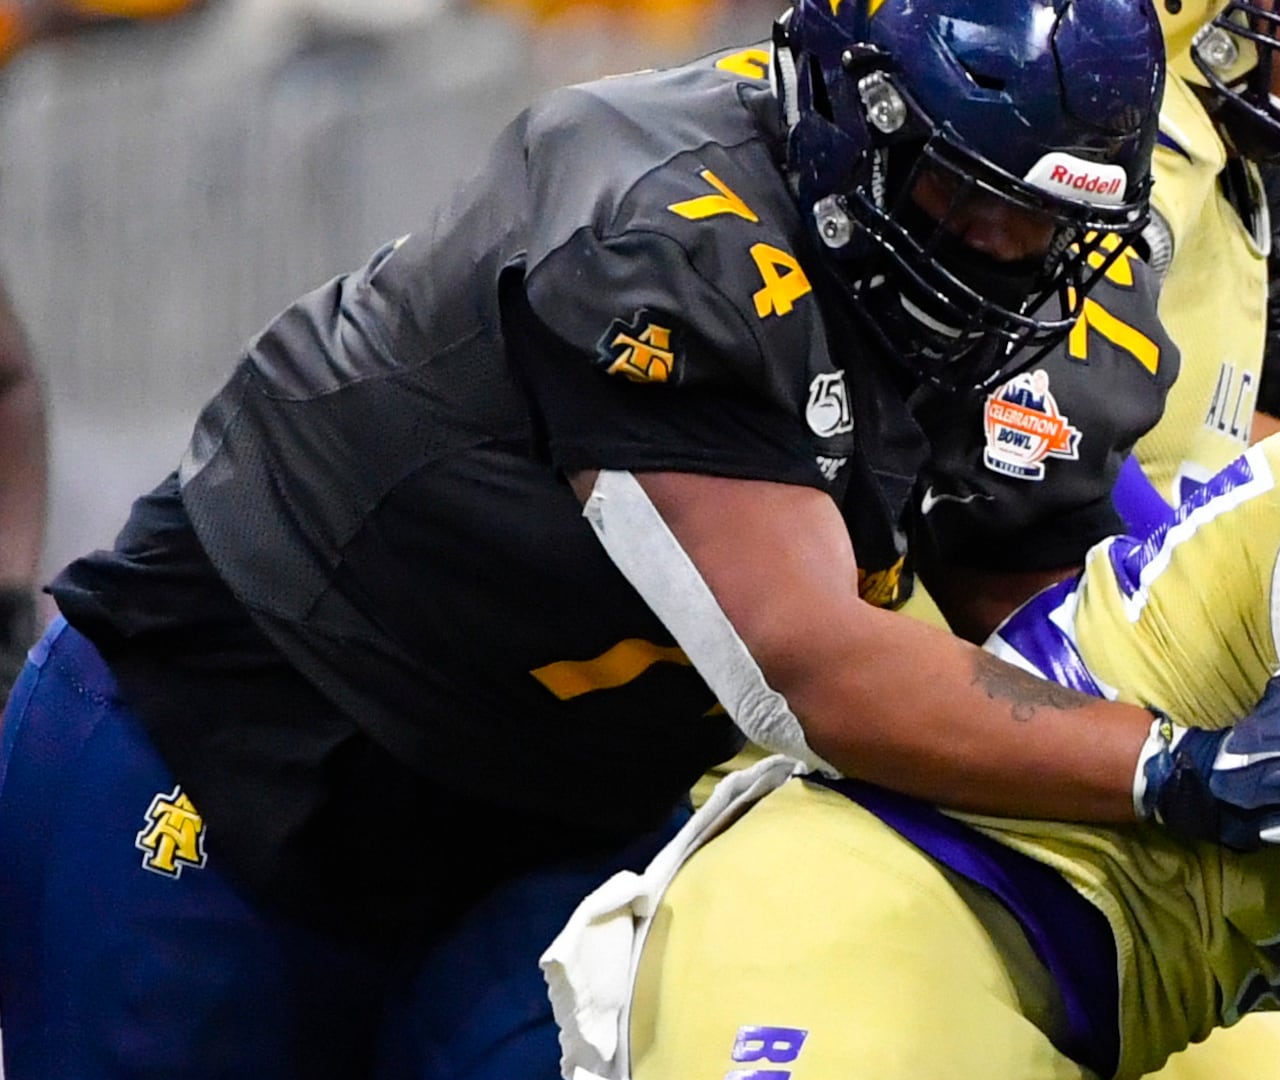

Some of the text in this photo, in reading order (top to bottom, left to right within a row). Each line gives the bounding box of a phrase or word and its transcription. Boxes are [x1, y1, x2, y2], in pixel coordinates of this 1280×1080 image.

[1050, 163, 1121, 196] Riddell
[667, 168, 811, 319] 74
[989, 404, 1059, 437] CELEBRATION
[997, 427, 1032, 450] BOWL
